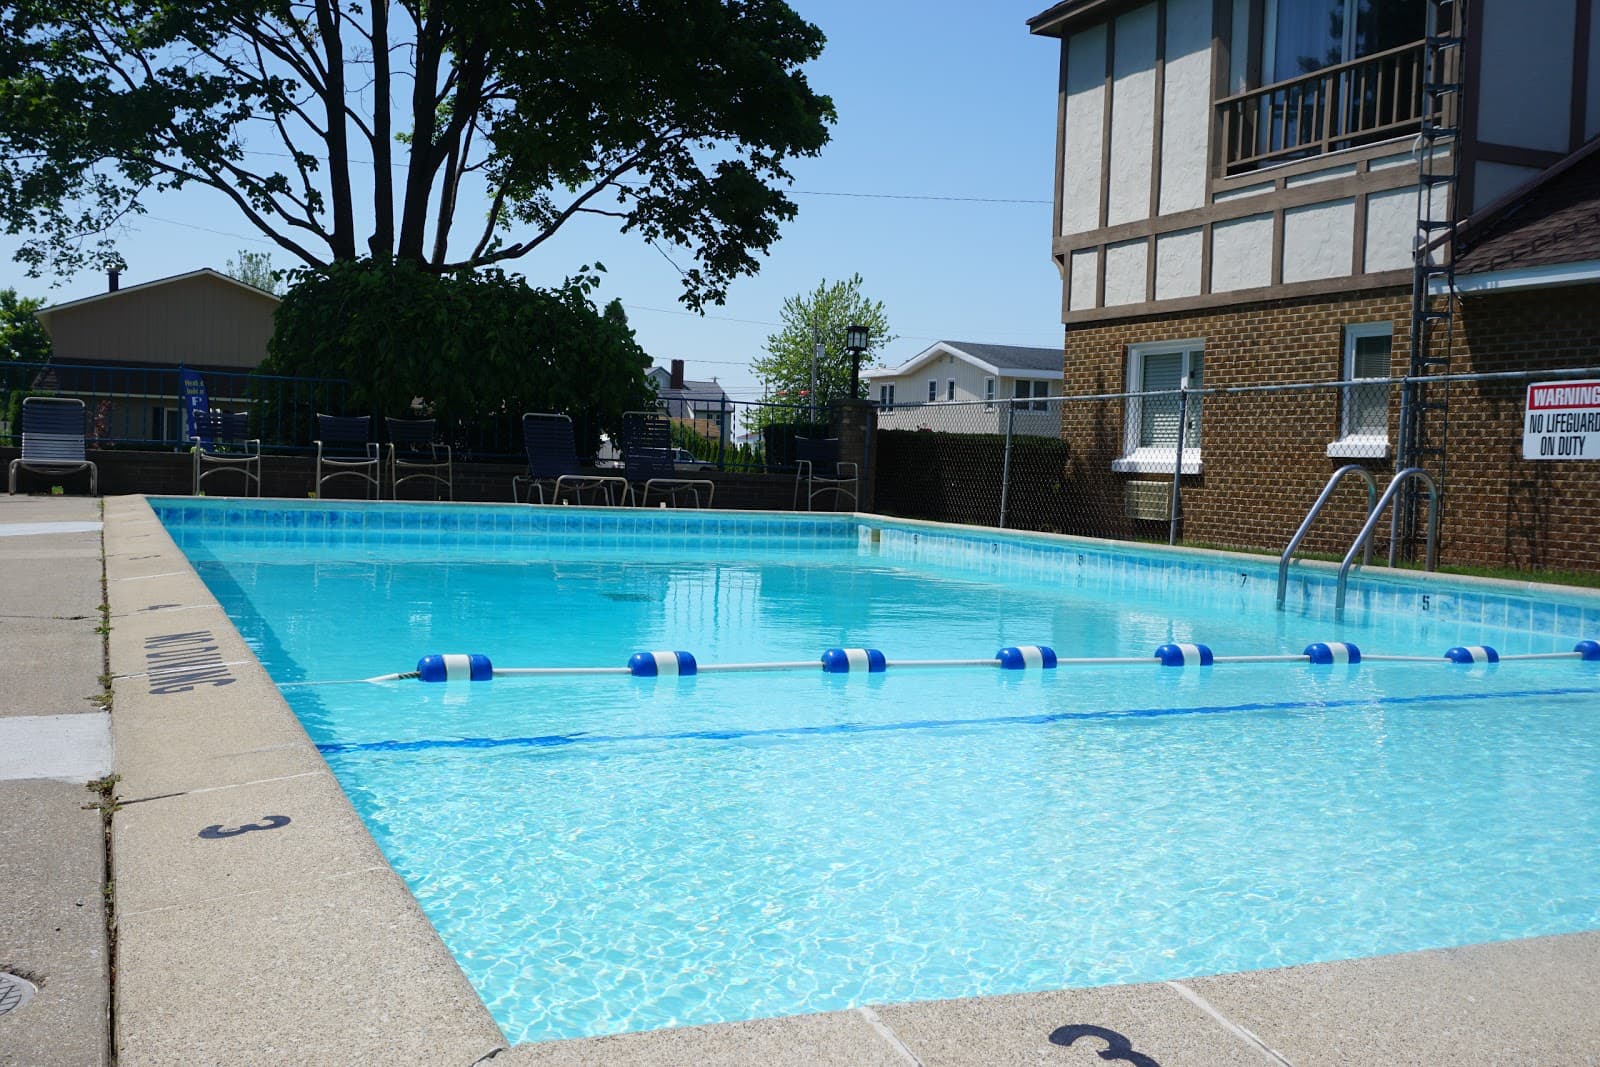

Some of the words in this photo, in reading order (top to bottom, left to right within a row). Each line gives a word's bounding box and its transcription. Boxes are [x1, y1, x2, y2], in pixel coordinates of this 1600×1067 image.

[1533, 386, 1600, 407] WARNING
[1529, 414, 1544, 434] NO
[1546, 412, 1600, 433] LIFEGUARD
[1540, 436, 1556, 456] ON
[1558, 436, 1586, 456] DUTY
[1241, 573, 1248, 588] 7
[1422, 594, 1430, 611] 5
[143, 630, 215, 649] NO
[145, 645, 237, 695] DIVING
[198, 815, 292, 840] 3
